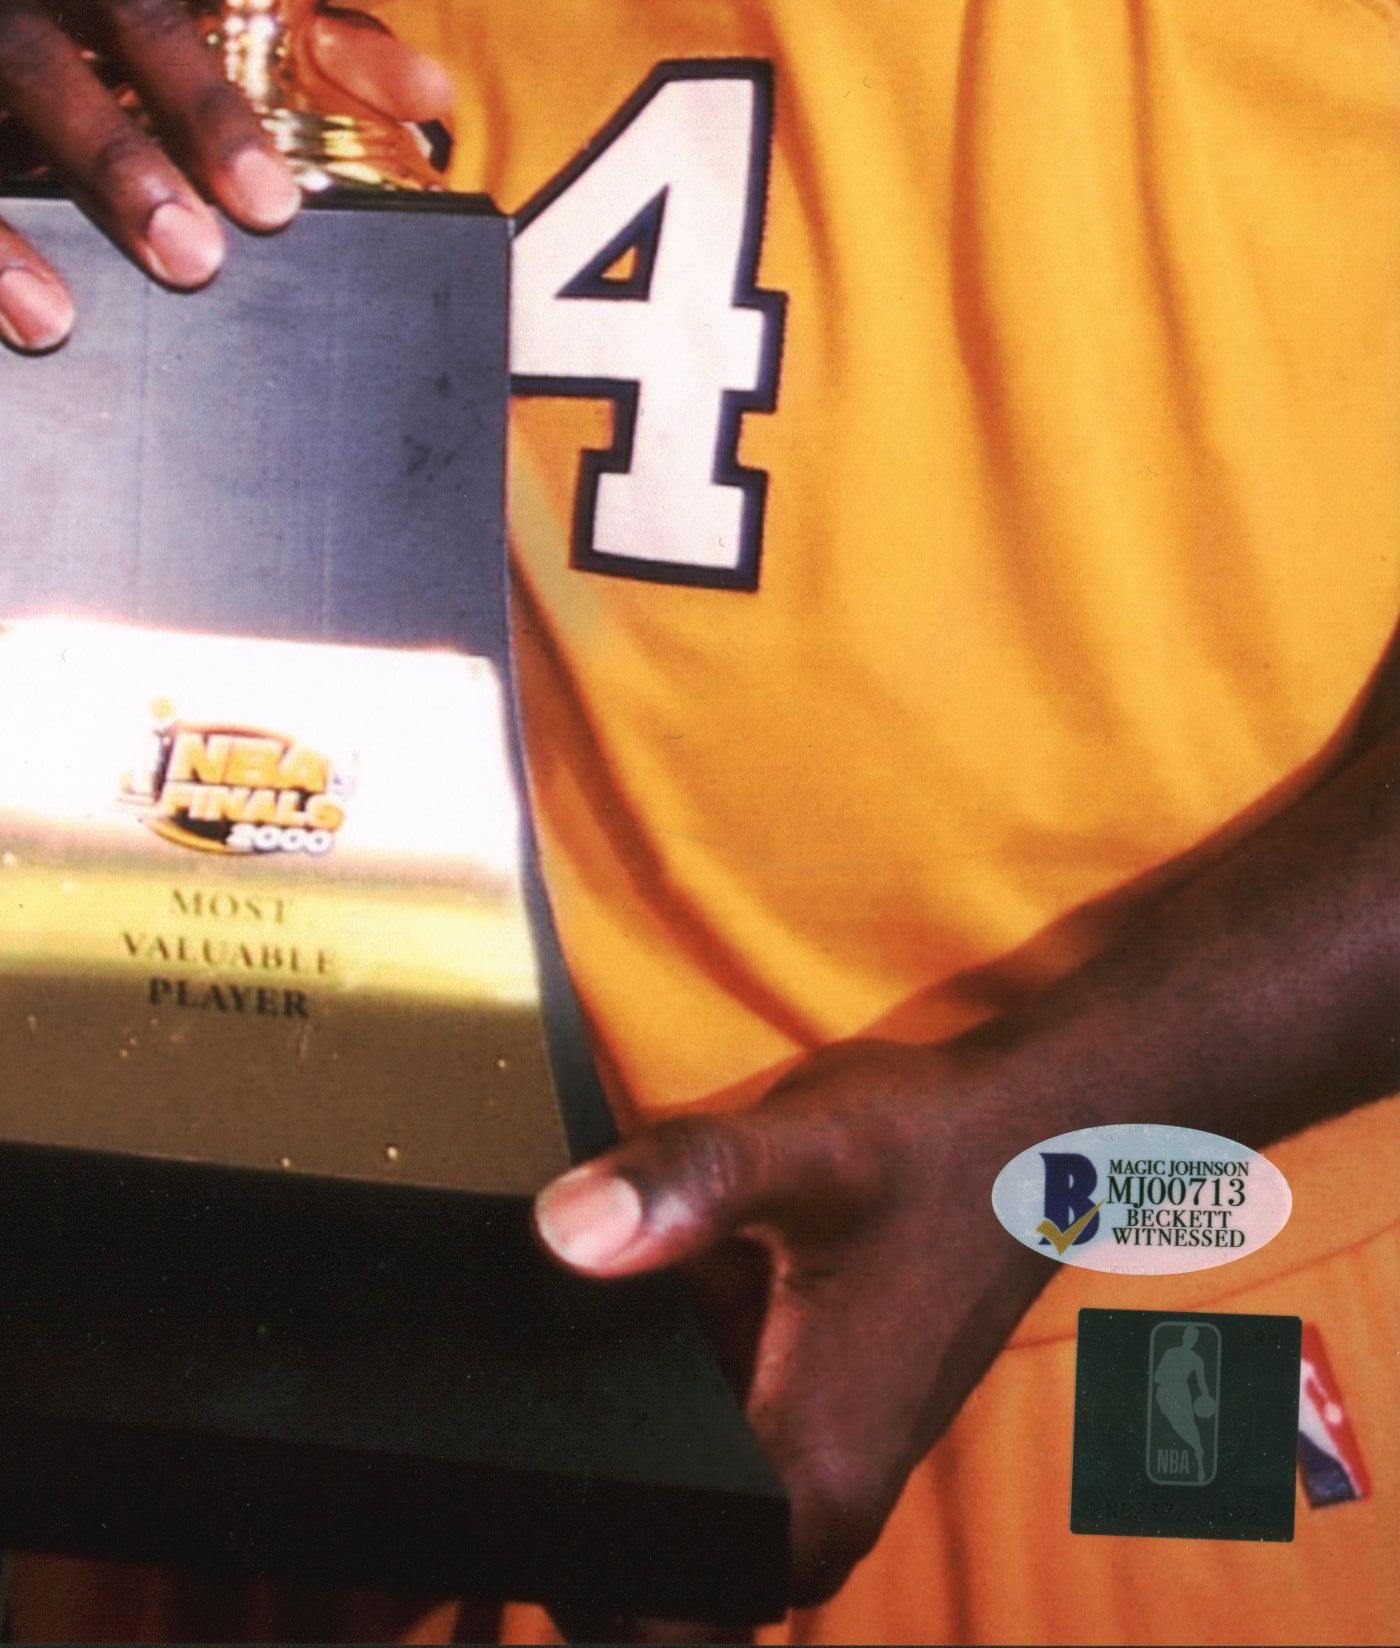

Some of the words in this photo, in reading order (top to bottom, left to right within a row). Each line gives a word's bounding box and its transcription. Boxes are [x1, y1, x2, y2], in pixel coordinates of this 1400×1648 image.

[508, 56, 790, 594] 4
[165, 731, 331, 794] NBA
[160, 779, 346, 832] FINALS
[225, 823, 335, 854] 2000
[170, 888, 291, 925] MOST
[121, 931, 335, 976] VALUABLE
[148, 977, 310, 1019] PLAYER
